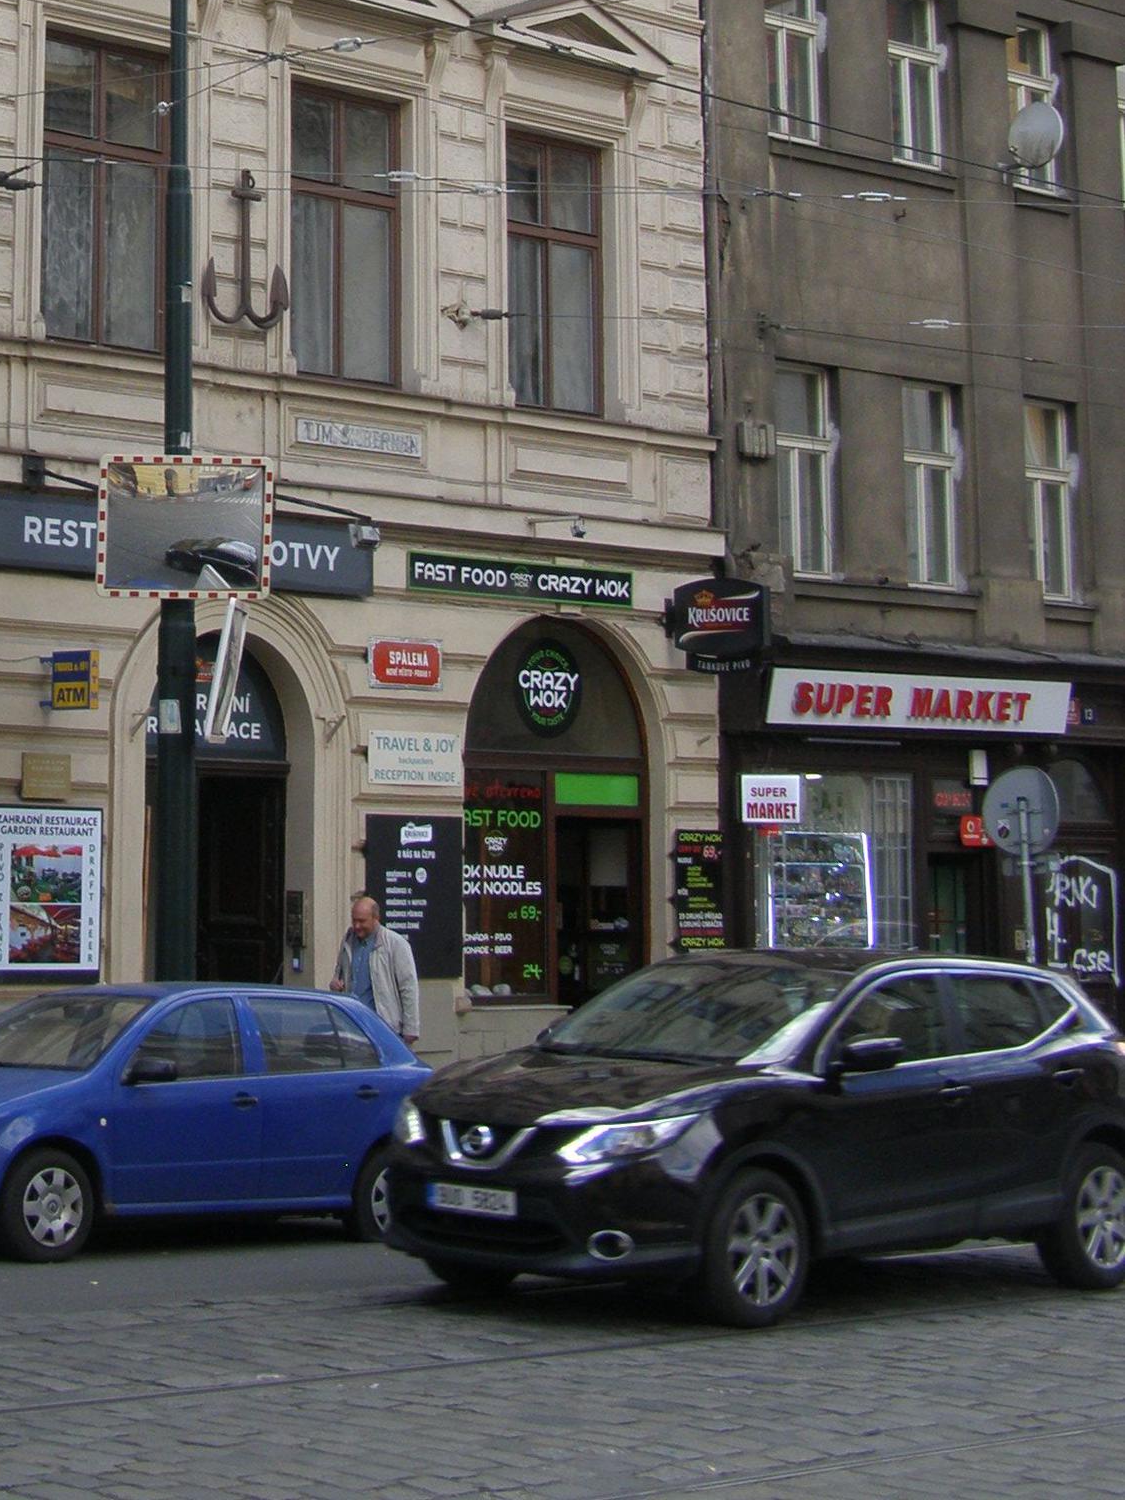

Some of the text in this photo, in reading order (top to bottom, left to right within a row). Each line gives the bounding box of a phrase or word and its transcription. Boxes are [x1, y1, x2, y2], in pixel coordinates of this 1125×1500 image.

[271, 540, 340, 572] OTVY
[415, 562, 630, 599] FAST FOOD CRAZY WOK
[687, 605, 750, 628] KRUŠOVICE
[388, 649, 429, 667] SPÁLENÁ
[518, 669, 580, 692] CRAZY
[56, 687, 85, 703] ATM
[529, 689, 567, 709] WOK
[793, 682, 894, 718] SUPER
[907, 687, 1033, 723] MARKET
[376, 735, 456, 753] TRAVEL & JOY
[374, 768, 456, 783] RECEPTION INSIDE
[750, 786, 787, 798] SUPER
[464, 809, 542, 829] AST FOOD
[746, 802, 797, 819] MARKET
[45, 816, 98, 827] RESTAURACE
[0, 825, 94, 838] GARDEN RESTAURANT
[463, 864, 525, 879] OK NUDLE
[463, 881, 543, 896] OK NOODLES
